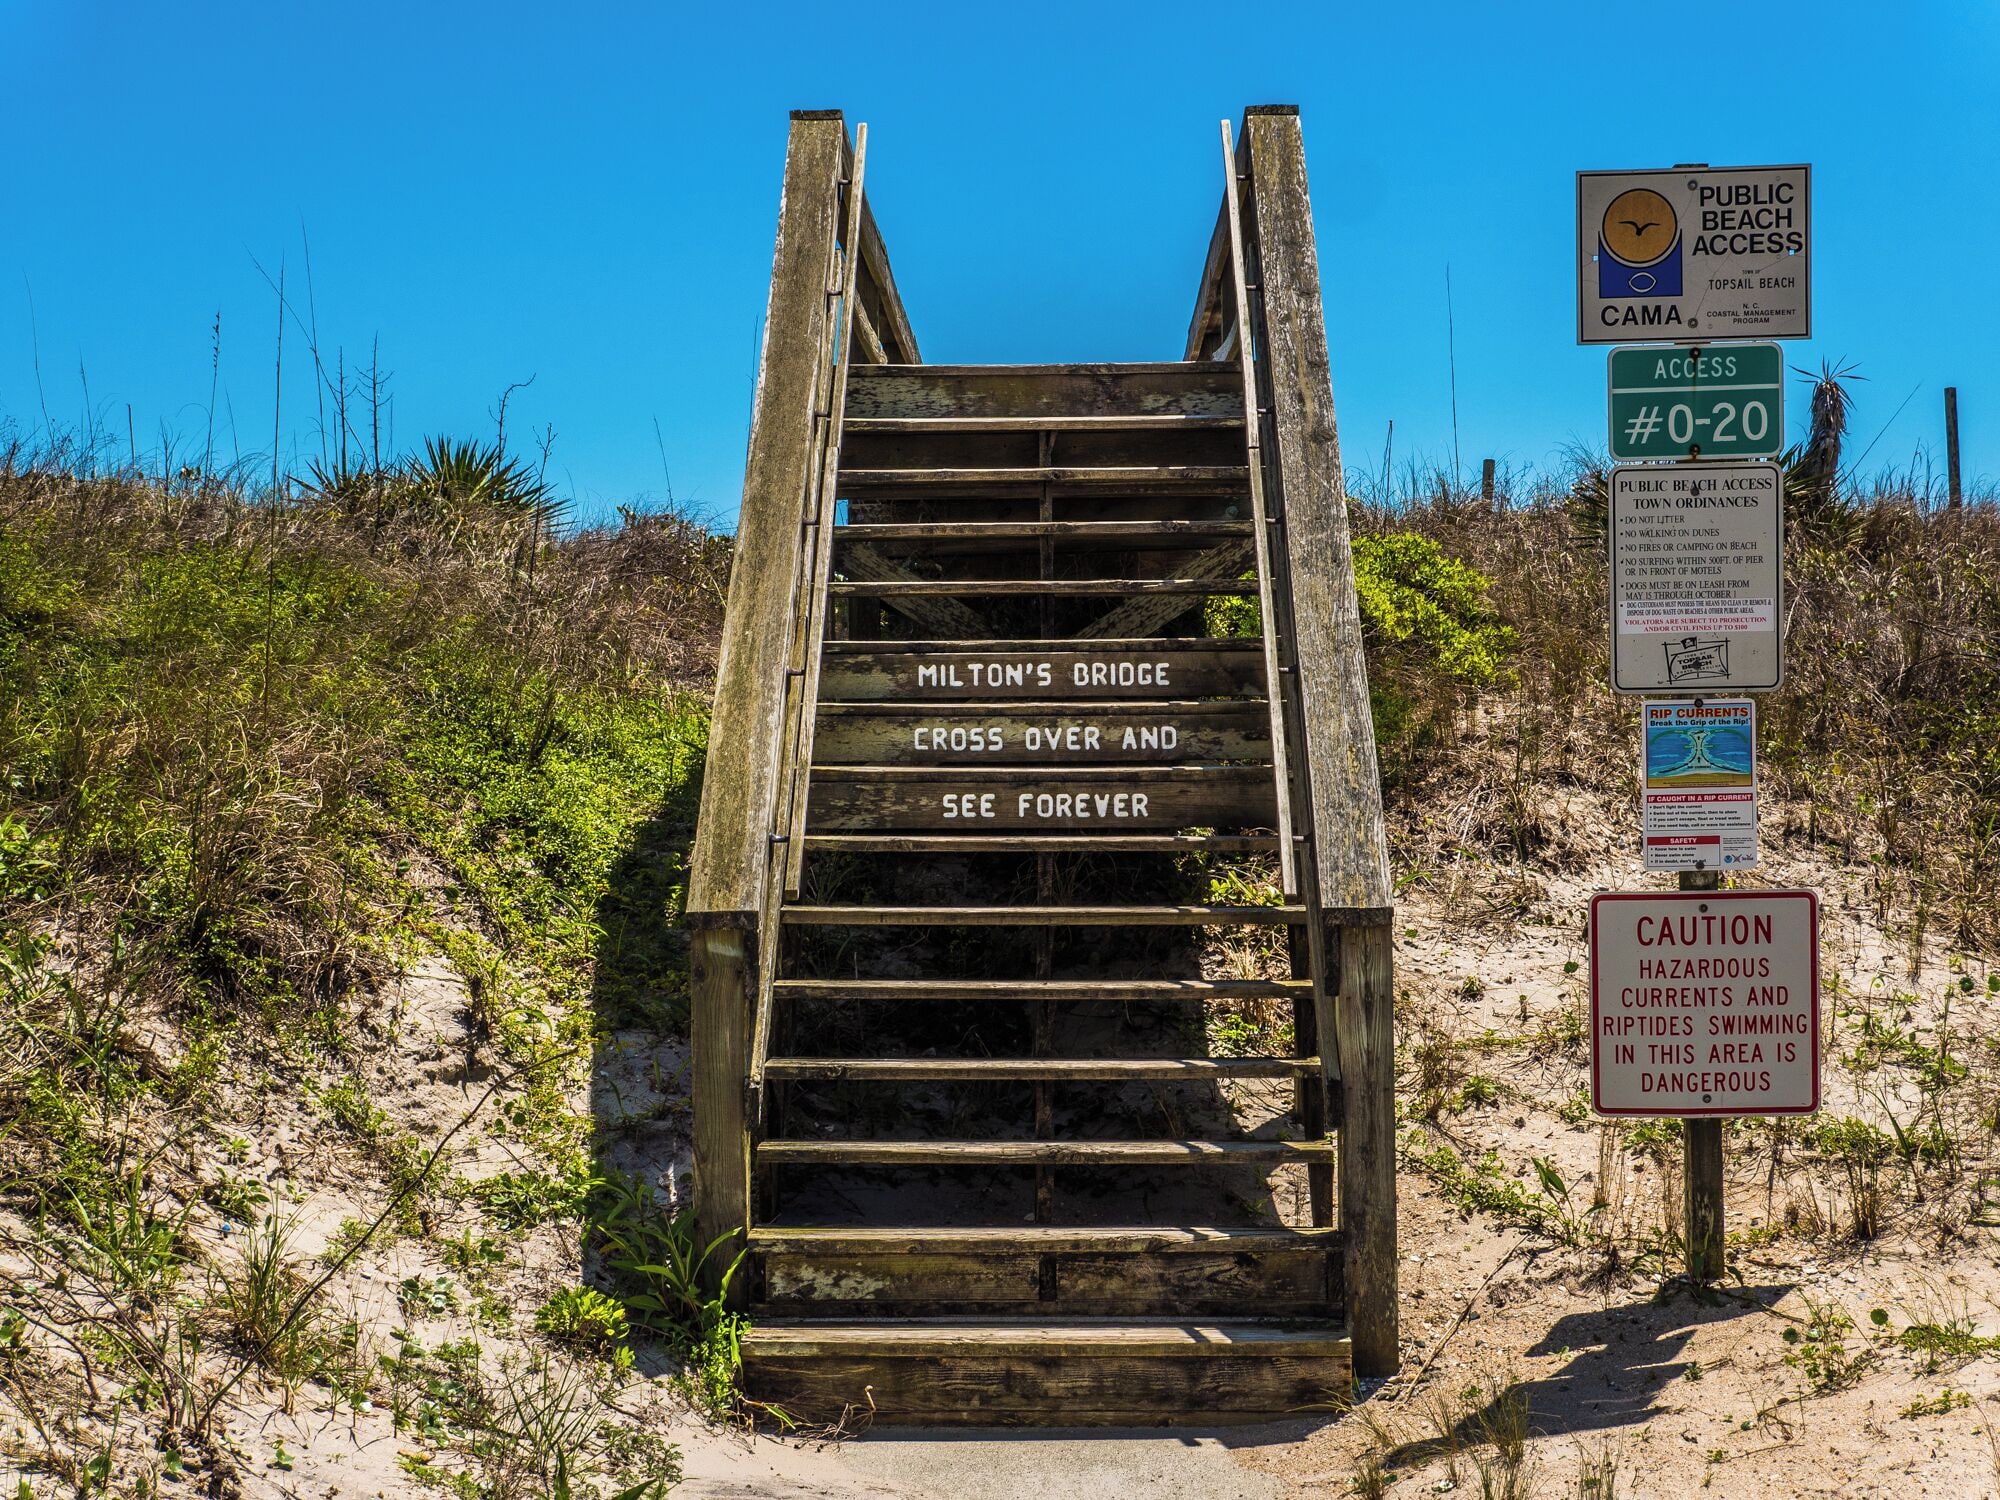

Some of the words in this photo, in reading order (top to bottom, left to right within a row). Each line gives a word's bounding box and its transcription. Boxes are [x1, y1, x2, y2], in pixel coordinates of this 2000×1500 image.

[1700, 183, 1794, 206] PUBLIC
[1702, 208, 1792, 231] BEACH
[1692, 232, 1802, 256] ACCESS
[1709, 279, 1754, 290] TOPSAIL
[1760, 277, 1794, 288] BEACH
[1601, 305, 1682, 326] CAMA
[1655, 357, 1737, 379] ACCESS
[1624, 401, 1768, 444] #0-20
[1620, 480, 1668, 492] PUBLIC
[1673, 479, 1717, 492] BEACH
[1722, 478, 1772, 490] ACCESS
[1633, 498, 1671, 509] TOWN
[1676, 496, 1758, 508] ORDINANCES
[1657, 515, 1684, 524] LITTER
[1639, 529, 1676, 537] WALKING
[1625, 544, 1636, 552] NO
[1639, 544, 1661, 552] FIRES
[1676, 542, 1713, 551] CAMPING
[1639, 557, 1674, 566] SURFING
[1677, 557, 1706, 565] WITHIN
[1650, 567, 1676, 575] FRONT
[1626, 592, 1643, 600] MAY
[1654, 591, 1693, 599] THROUGH
[1677, 655, 1714, 664] TOPSAIL
[1682, 660, 1712, 670] BECH
[918, 663, 1052, 687] MILTON'S
[1073, 662, 1170, 686] BRIDGE
[1650, 709, 1672, 718] RIP
[1677, 708, 1748, 718] CURRENTS
[914, 727, 1002, 752] CROSS
[1025, 726, 1100, 751] OVER
[1121, 726, 1178, 751] AND
[942, 794, 996, 818] SEE
[1018, 794, 1148, 818] FOREVER
[1637, 915, 1772, 946] CAUTION
[1640, 958, 1770, 979] HAZARDOUS
[1621, 987, 1732, 1008] CURRENTS
[1747, 986, 1789, 1006] AND
[1603, 1016, 1693, 1036] RIPTIDES
[1709, 1014, 1807, 1036] SWIMMING
[1615, 1045, 1634, 1064] IN
[1648, 1044, 1694, 1064] THIS
[1709, 1043, 1763, 1064] AREA
[1777, 1043, 1795, 1063] IS
[1642, 1072, 1771, 1092] DANGEROUS
